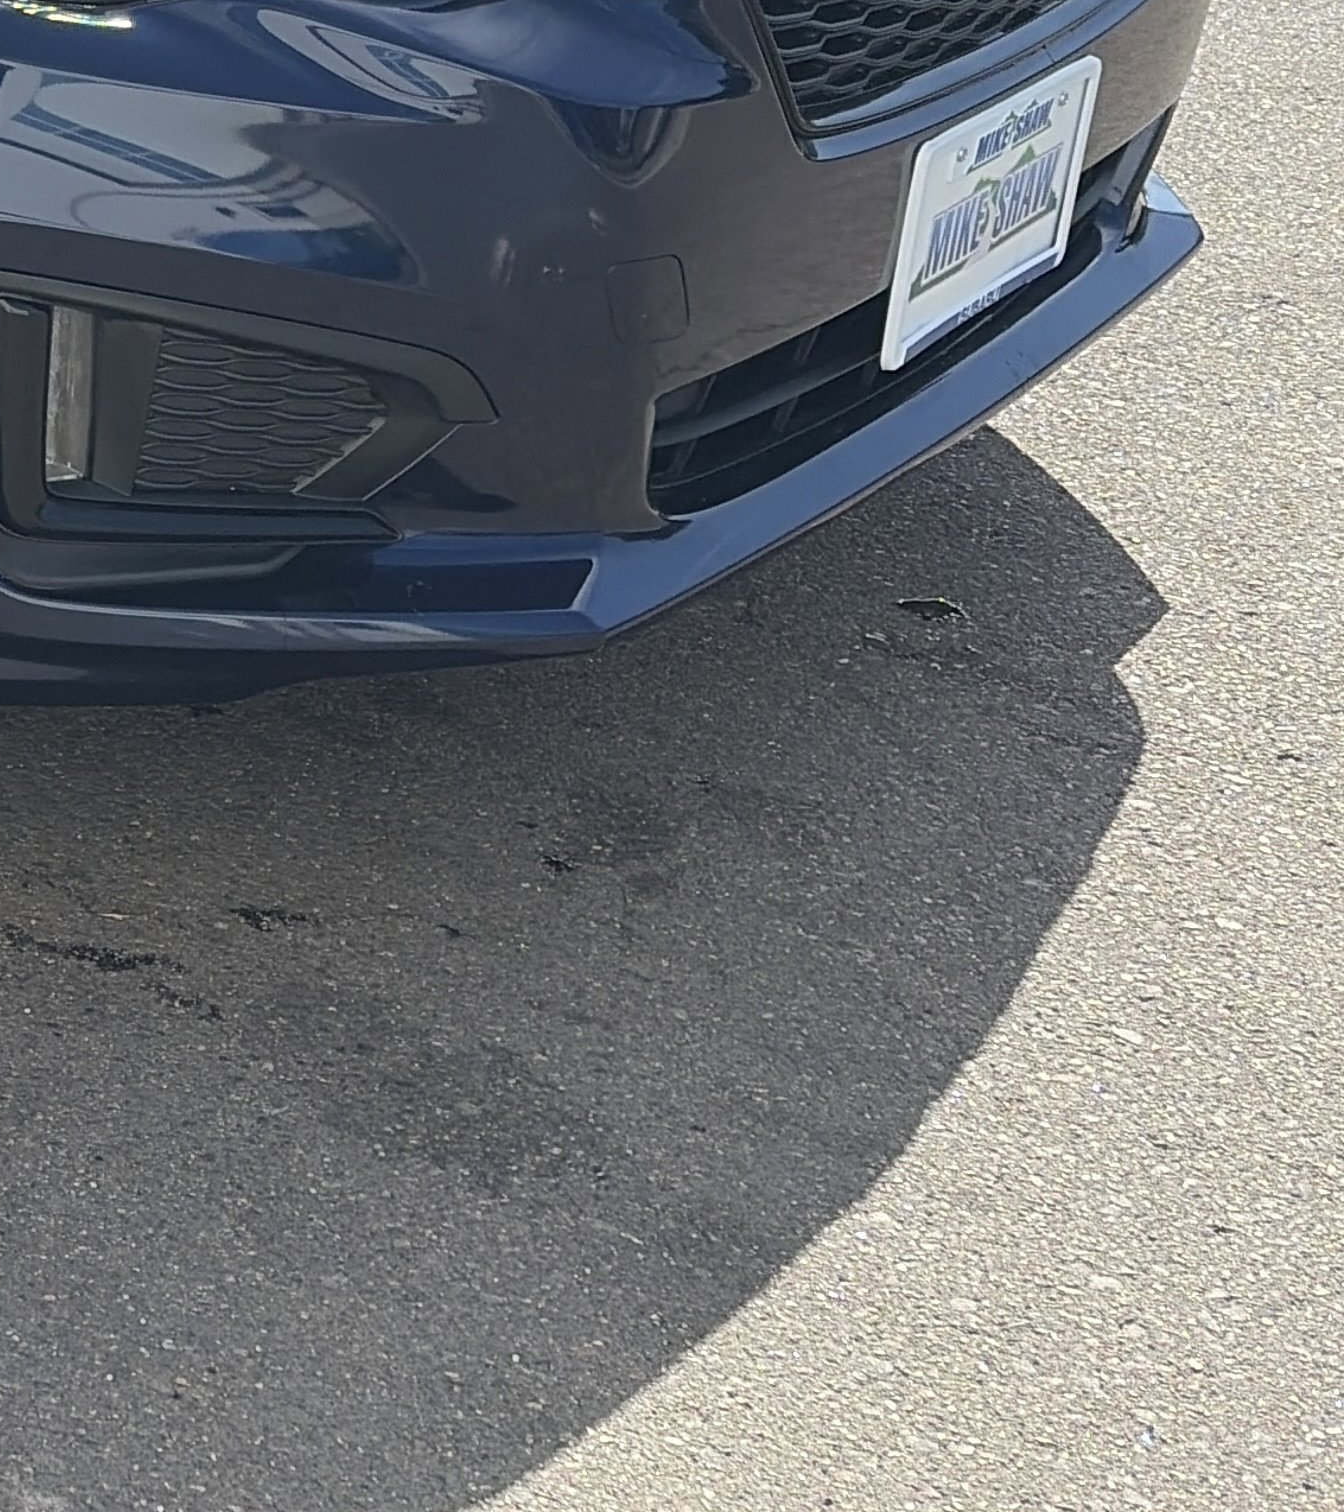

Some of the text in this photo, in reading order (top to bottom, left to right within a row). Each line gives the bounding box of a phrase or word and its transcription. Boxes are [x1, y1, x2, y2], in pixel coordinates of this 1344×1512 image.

[974, 98, 1054, 165] MIKE SHAW
[924, 147, 1060, 280] MIKE SHAW
